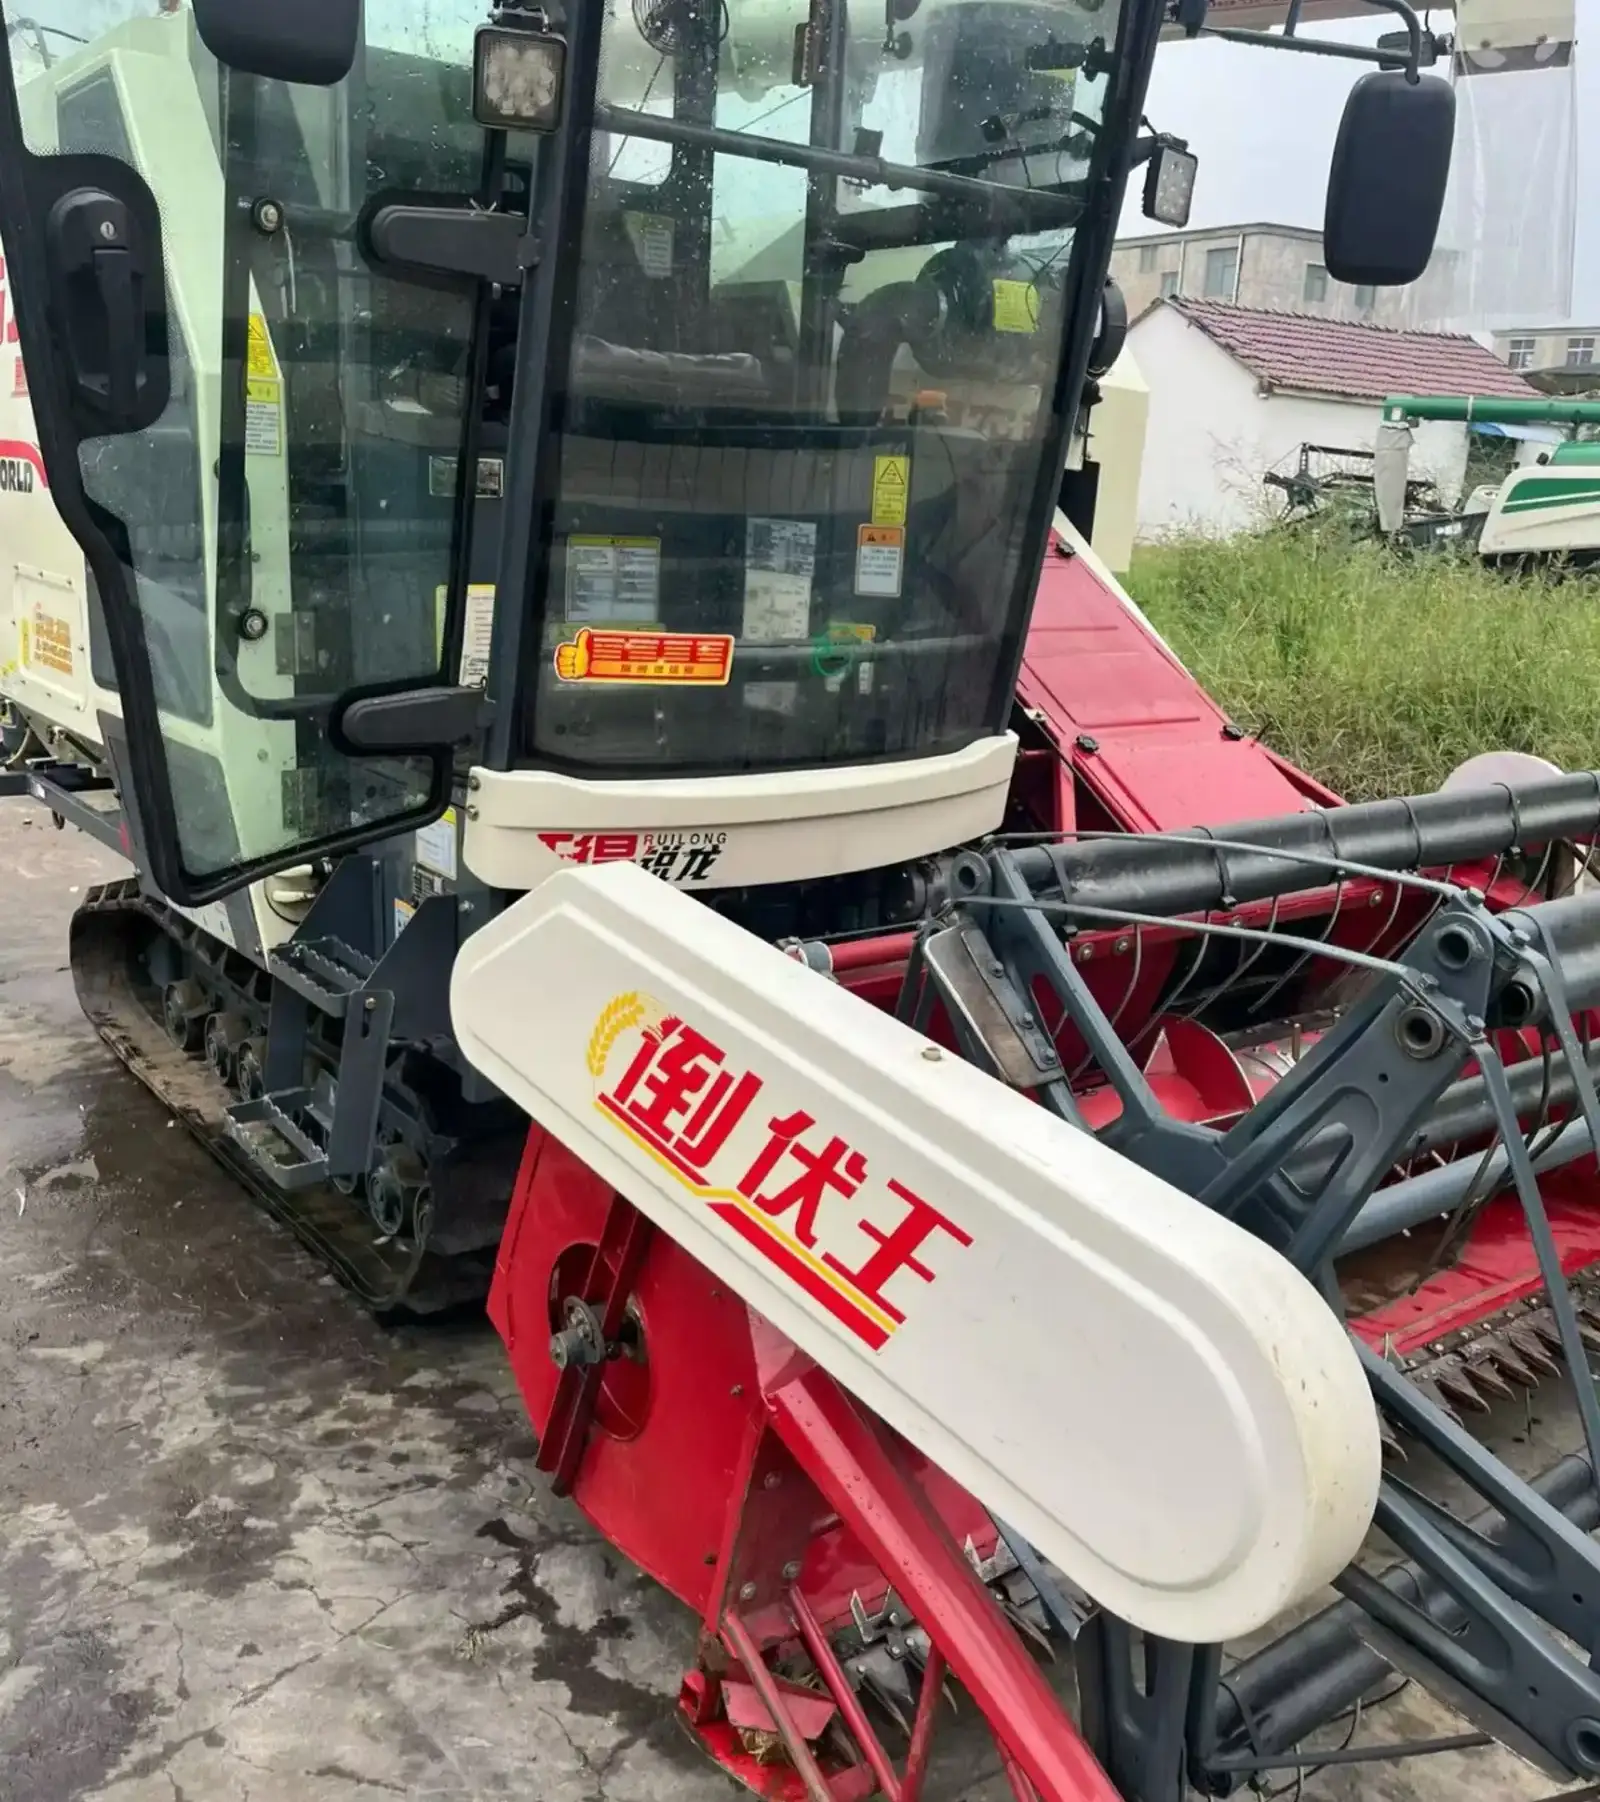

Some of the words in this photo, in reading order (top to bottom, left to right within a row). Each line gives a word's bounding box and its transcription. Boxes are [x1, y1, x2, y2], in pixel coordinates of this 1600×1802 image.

[643, 832, 728, 845] RUILONG
[613, 1015, 974, 1325] 倒伏王
